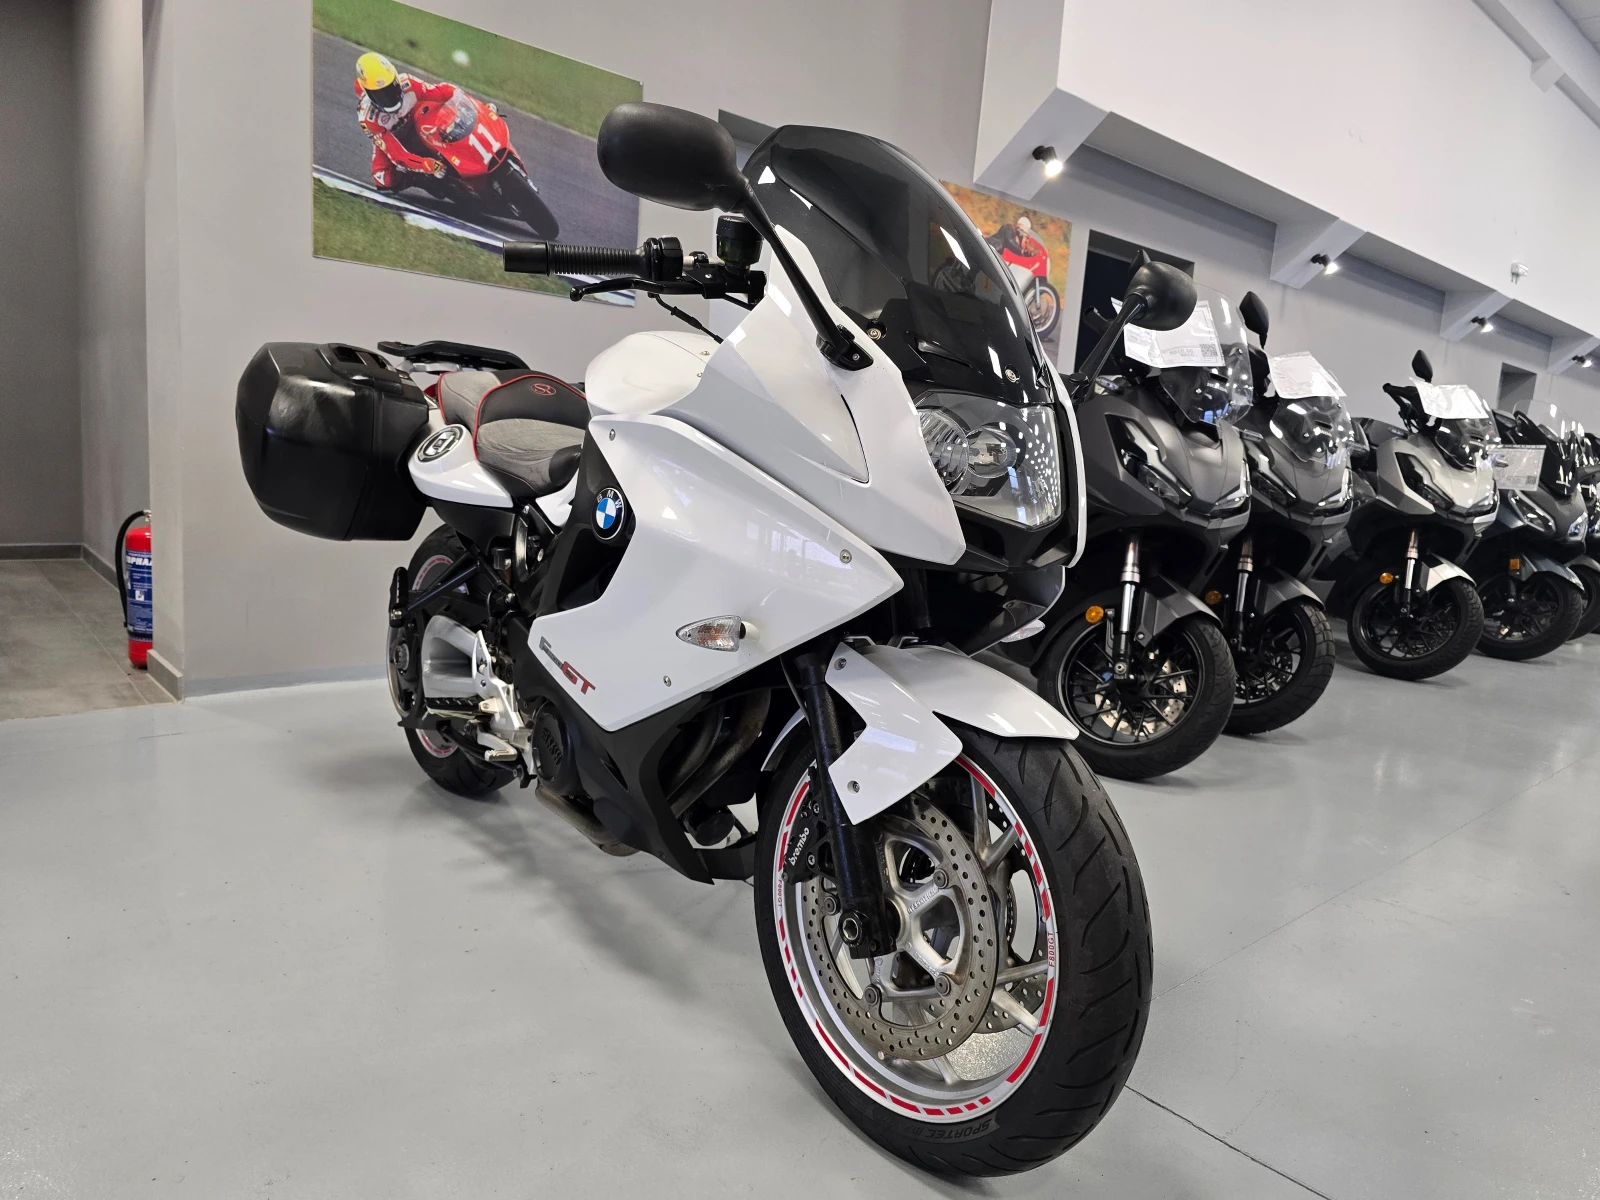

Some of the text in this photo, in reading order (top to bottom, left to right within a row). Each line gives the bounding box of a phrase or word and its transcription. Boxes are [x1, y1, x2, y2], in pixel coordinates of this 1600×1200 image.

[469, 123, 501, 165] 11
[596, 489, 622, 508] BMW
[788, 827, 810, 866] brembo
[1047, 931, 1055, 968] F800GT
[925, 1118, 993, 1139] SPORTEC
